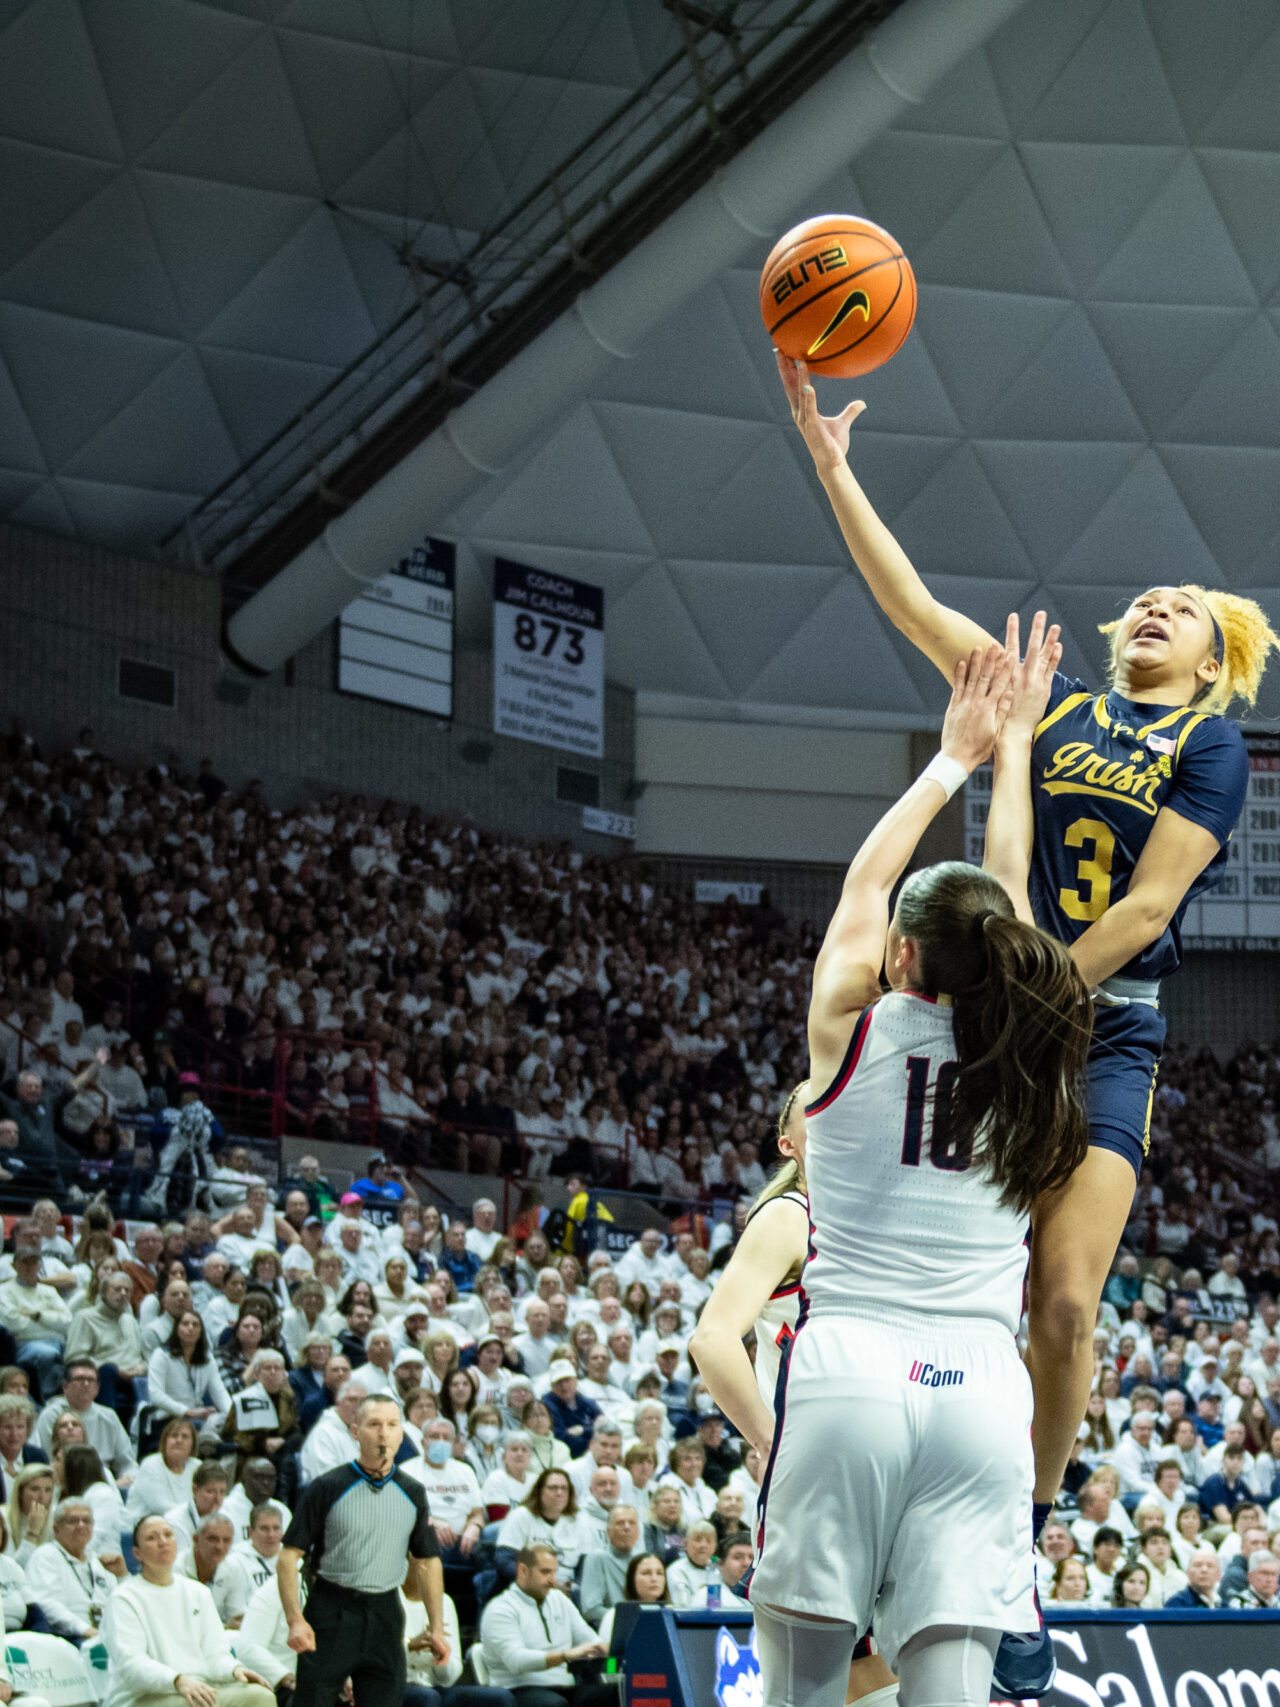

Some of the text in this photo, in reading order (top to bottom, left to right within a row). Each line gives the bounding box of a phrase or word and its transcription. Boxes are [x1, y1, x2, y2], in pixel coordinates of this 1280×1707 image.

[505, 586, 596, 622] JIM CALHOUN
[526, 573, 575, 598] COACH
[514, 612, 585, 665] 873
[1043, 740, 1165, 808] Irish
[1058, 817, 1116, 922] 3
[908, 1360, 964, 1388] UConn
